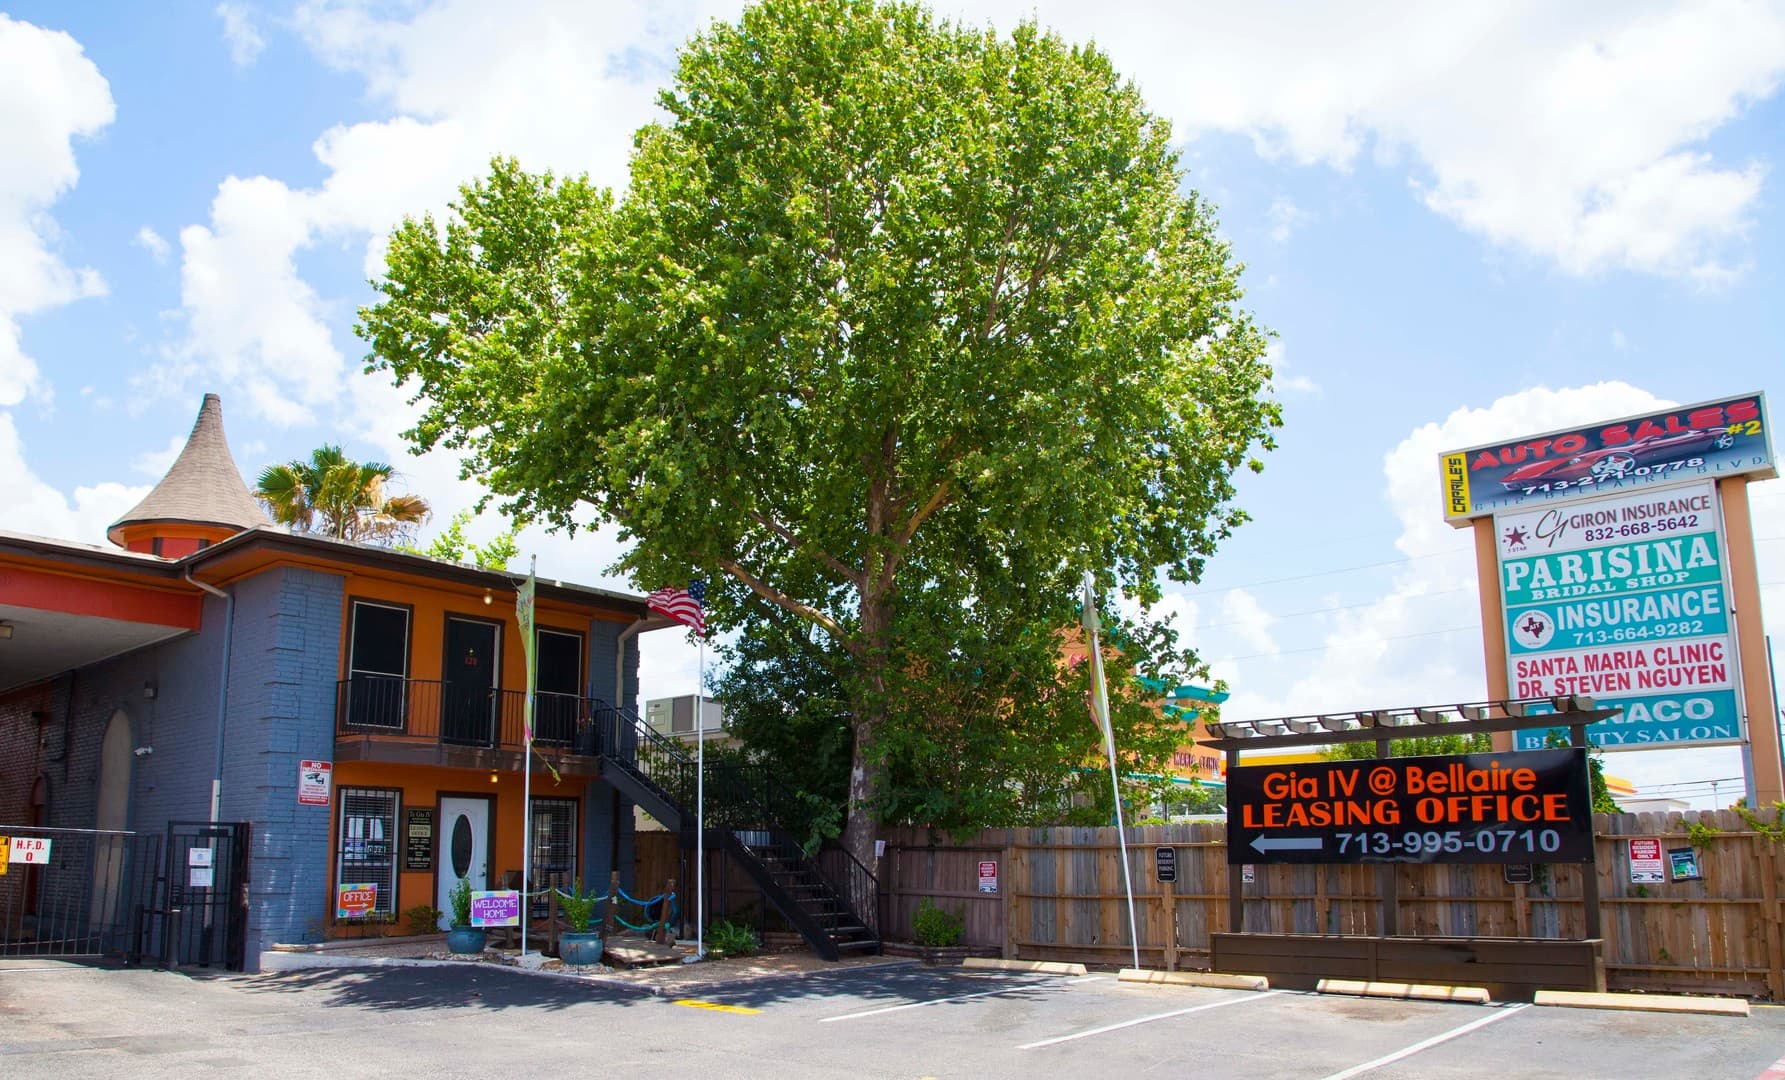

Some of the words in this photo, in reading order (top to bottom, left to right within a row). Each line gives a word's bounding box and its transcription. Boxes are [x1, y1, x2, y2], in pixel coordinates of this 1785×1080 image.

[1471, 434, 1587, 471] AUTO
[1600, 400, 1760, 447] SALES
[1727, 420, 1762, 437] #2
[1522, 457, 1705, 496] 713-271-0778
[1570, 510, 1618, 530] GIRON
[1622, 495, 1711, 523] INSURANCE
[1585, 514, 1698, 542] 832-668-5642
[1504, 536, 1718, 592] PARISINA
[1531, 582, 1617, 601] BRIDAL
[1626, 571, 1690, 589] SHOP
[1557, 588, 1721, 631] INSURANCE
[1573, 620, 1704, 645] 713-664-9282
[1516, 656, 1579, 679] SANTA
[1584, 650, 1648, 671] MARIA
[1653, 642, 1723, 667] CLINIC
[1517, 679, 1549, 699] DR.
[1555, 671, 1632, 696] STEVEN
[1638, 664, 1727, 689] NGUYEN
[1535, 698, 1715, 728] NACO
[1637, 725, 1731, 742] SALON
[1263, 771, 1319, 800] Gia
[1328, 769, 1359, 798] IV
[1368, 766, 1397, 796] @
[1406, 761, 1537, 795] Bellaire
[1243, 799, 1400, 828] LEASING
[1415, 794, 1571, 824] OFFICE
[16, 840, 45, 850] H.F.D.
[1335, 829, 1561, 855] 713-995-0710
[343, 892, 373, 902] OFFICE
[473, 899, 517, 909] WELCOME
[483, 909, 508, 919] HOME
